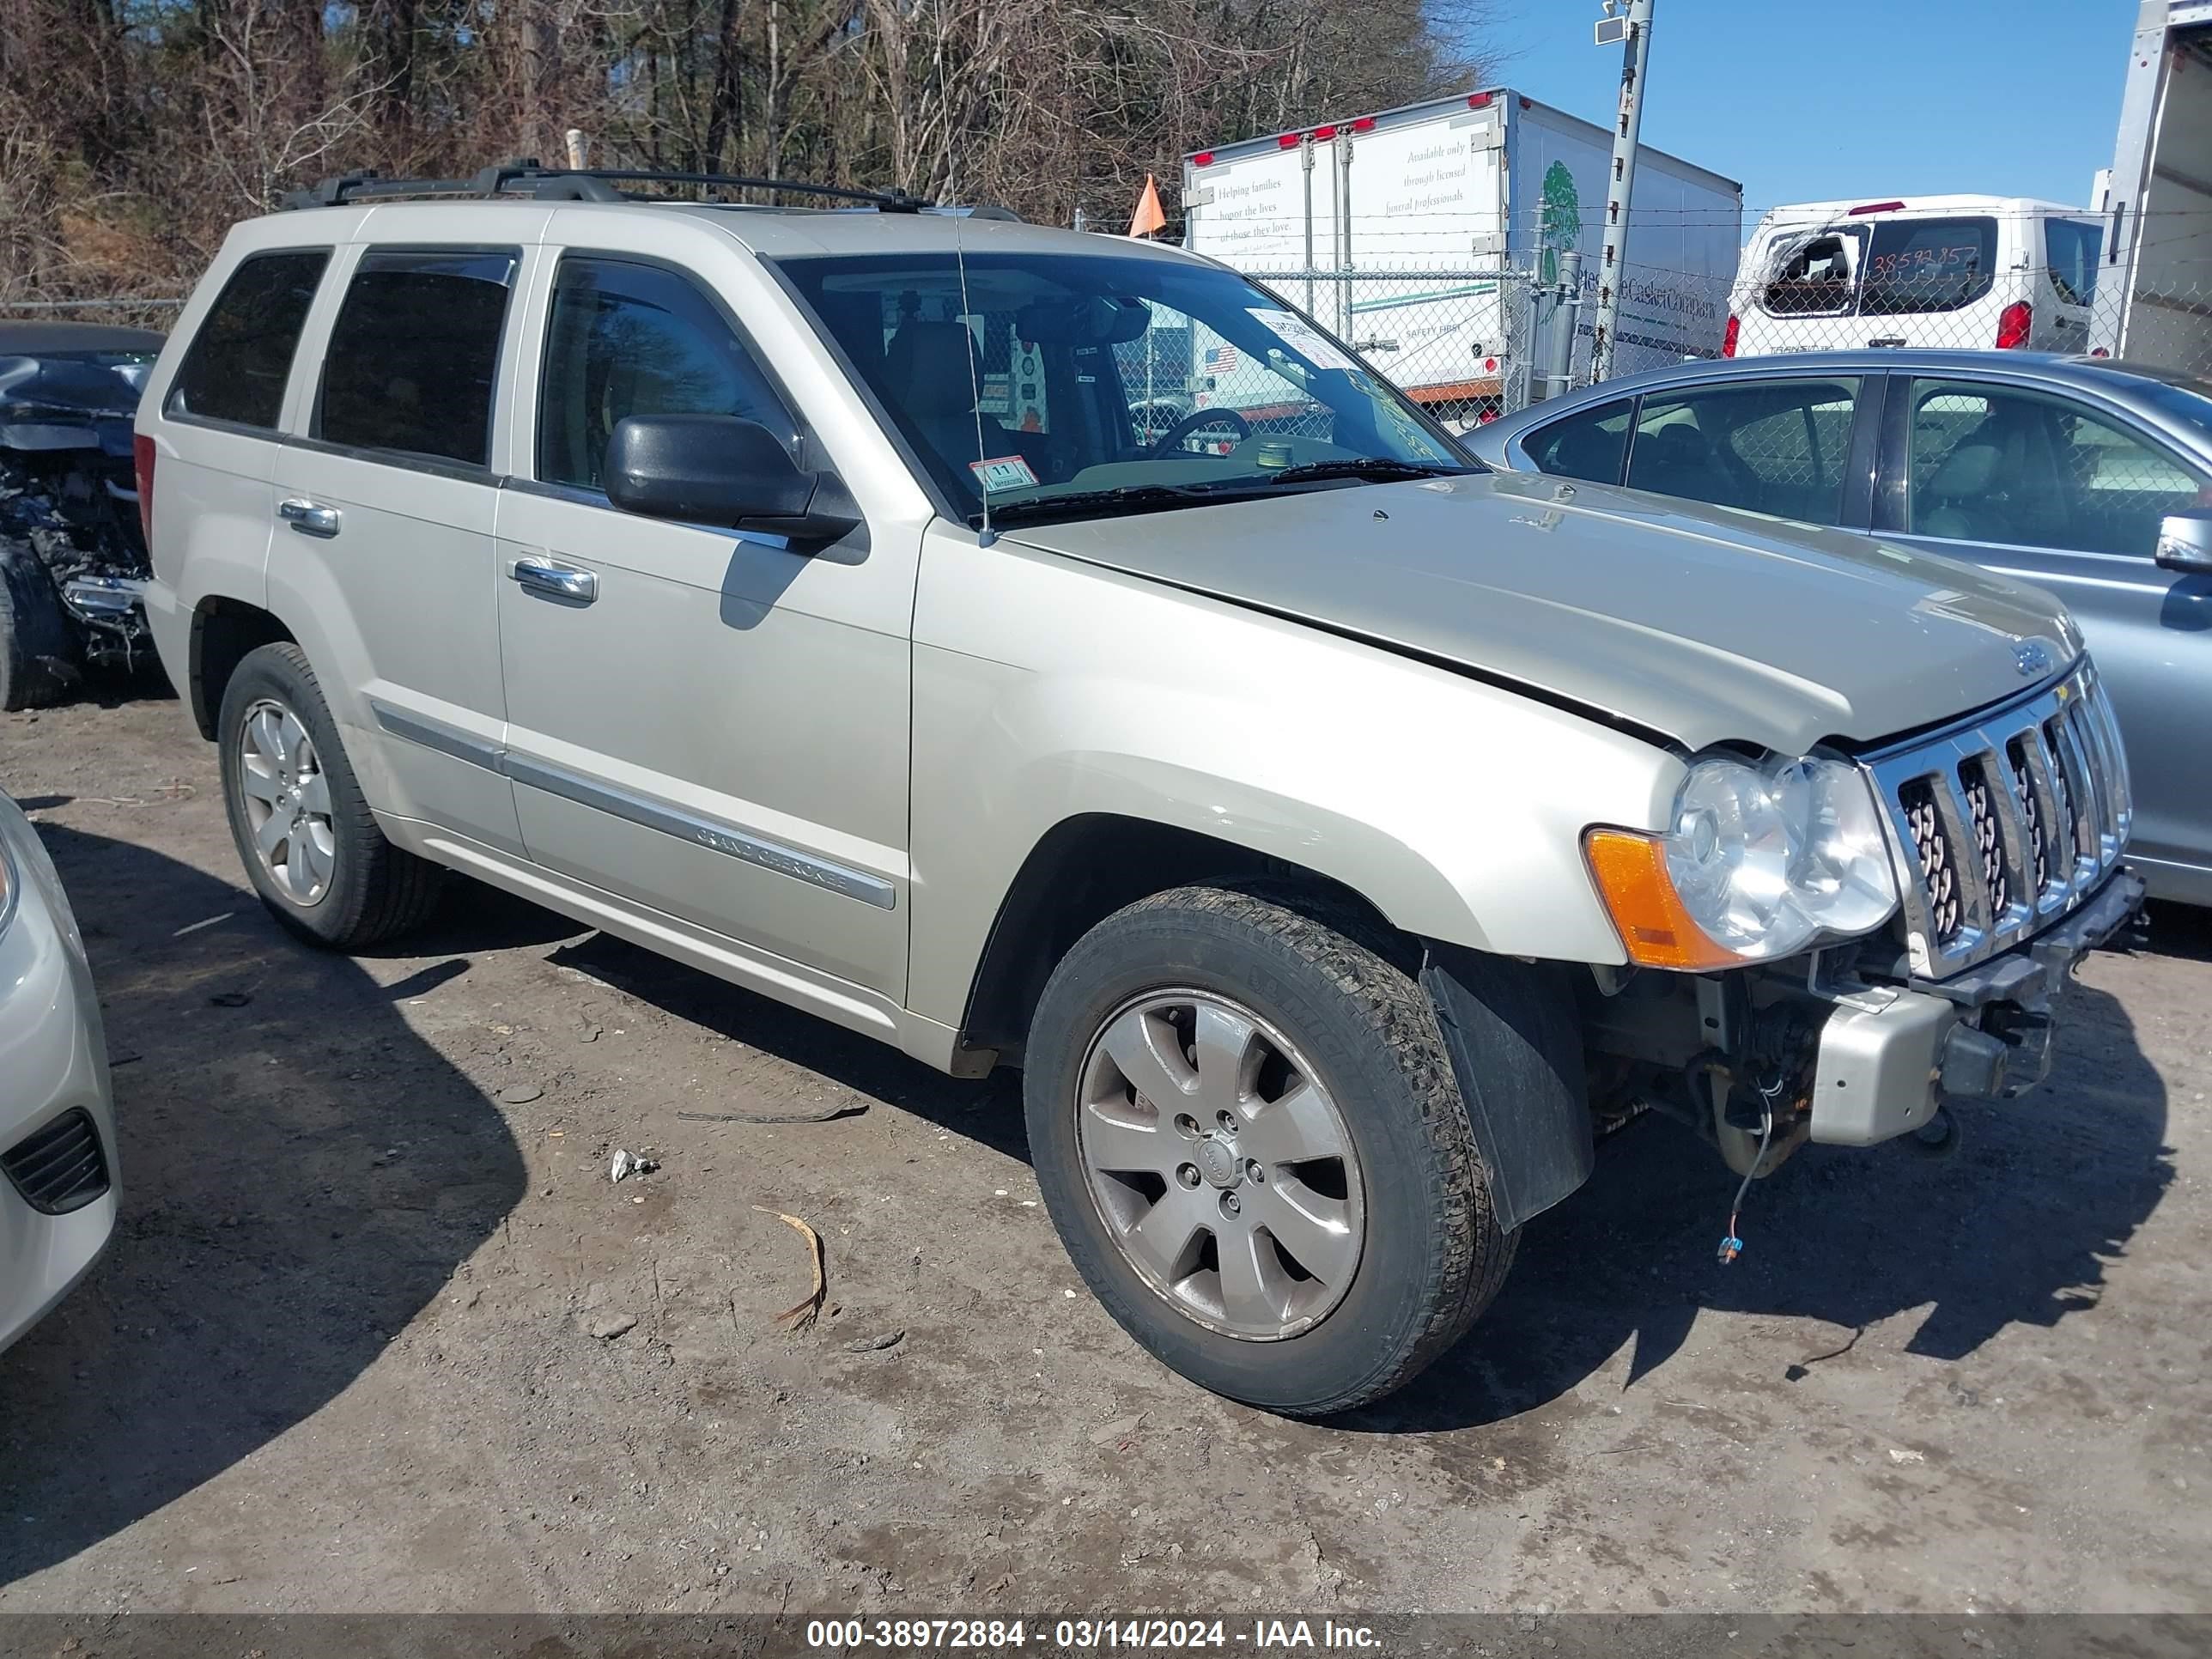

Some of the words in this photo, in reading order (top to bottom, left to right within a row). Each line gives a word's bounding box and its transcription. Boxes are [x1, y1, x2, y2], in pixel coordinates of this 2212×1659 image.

[1408, 143, 1445, 163] Available
[1447, 141, 1465, 155] only
[1404, 171, 1434, 186] through
[1437, 163, 1466, 180] licensed
[1219, 187, 1249, 199] Helping
[1252, 179, 1281, 192] families
[1219, 210, 1243, 221] honor
[1245, 206, 1257, 216] the
[1259, 204, 1277, 214] lives
[1386, 198, 1413, 216] funeral
[1415, 188, 1463, 211] professionals
[1220, 230, 1228, 242] of
[1231, 229, 1251, 240] those
[1254, 225, 1270, 237] they
[1273, 222, 1291, 234] love.
[1873, 246, 1978, 278] 38592857
[1406, 326, 1437, 337] SAFETY
[993, 465, 1011, 476] 11
[696, 829, 751, 856] GRAND
[758, 848, 848, 890] CHEROKEE
[1204, 1146, 1224, 1177] Jeep
